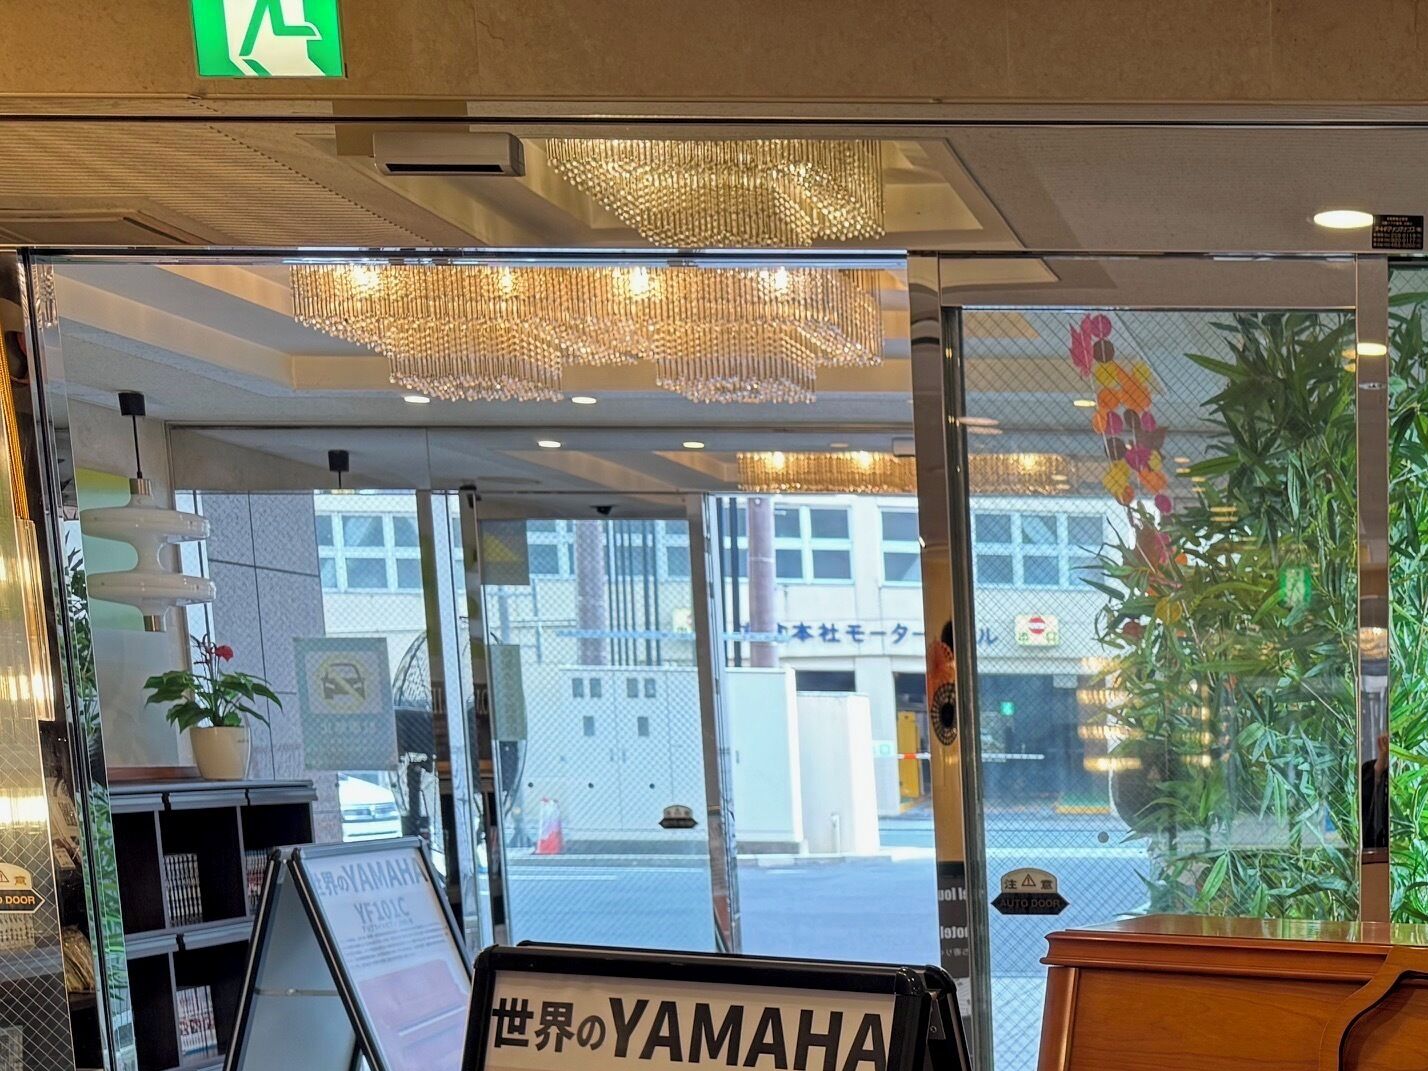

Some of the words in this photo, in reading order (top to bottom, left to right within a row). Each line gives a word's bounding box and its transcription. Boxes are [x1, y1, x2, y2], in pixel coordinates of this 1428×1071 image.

[5, 895, 36, 905] DOOR
[1000, 899, 1028, 908] AUTO
[1031, 899, 1061, 908] DOOR
[353, 896, 411, 925] YF101C
